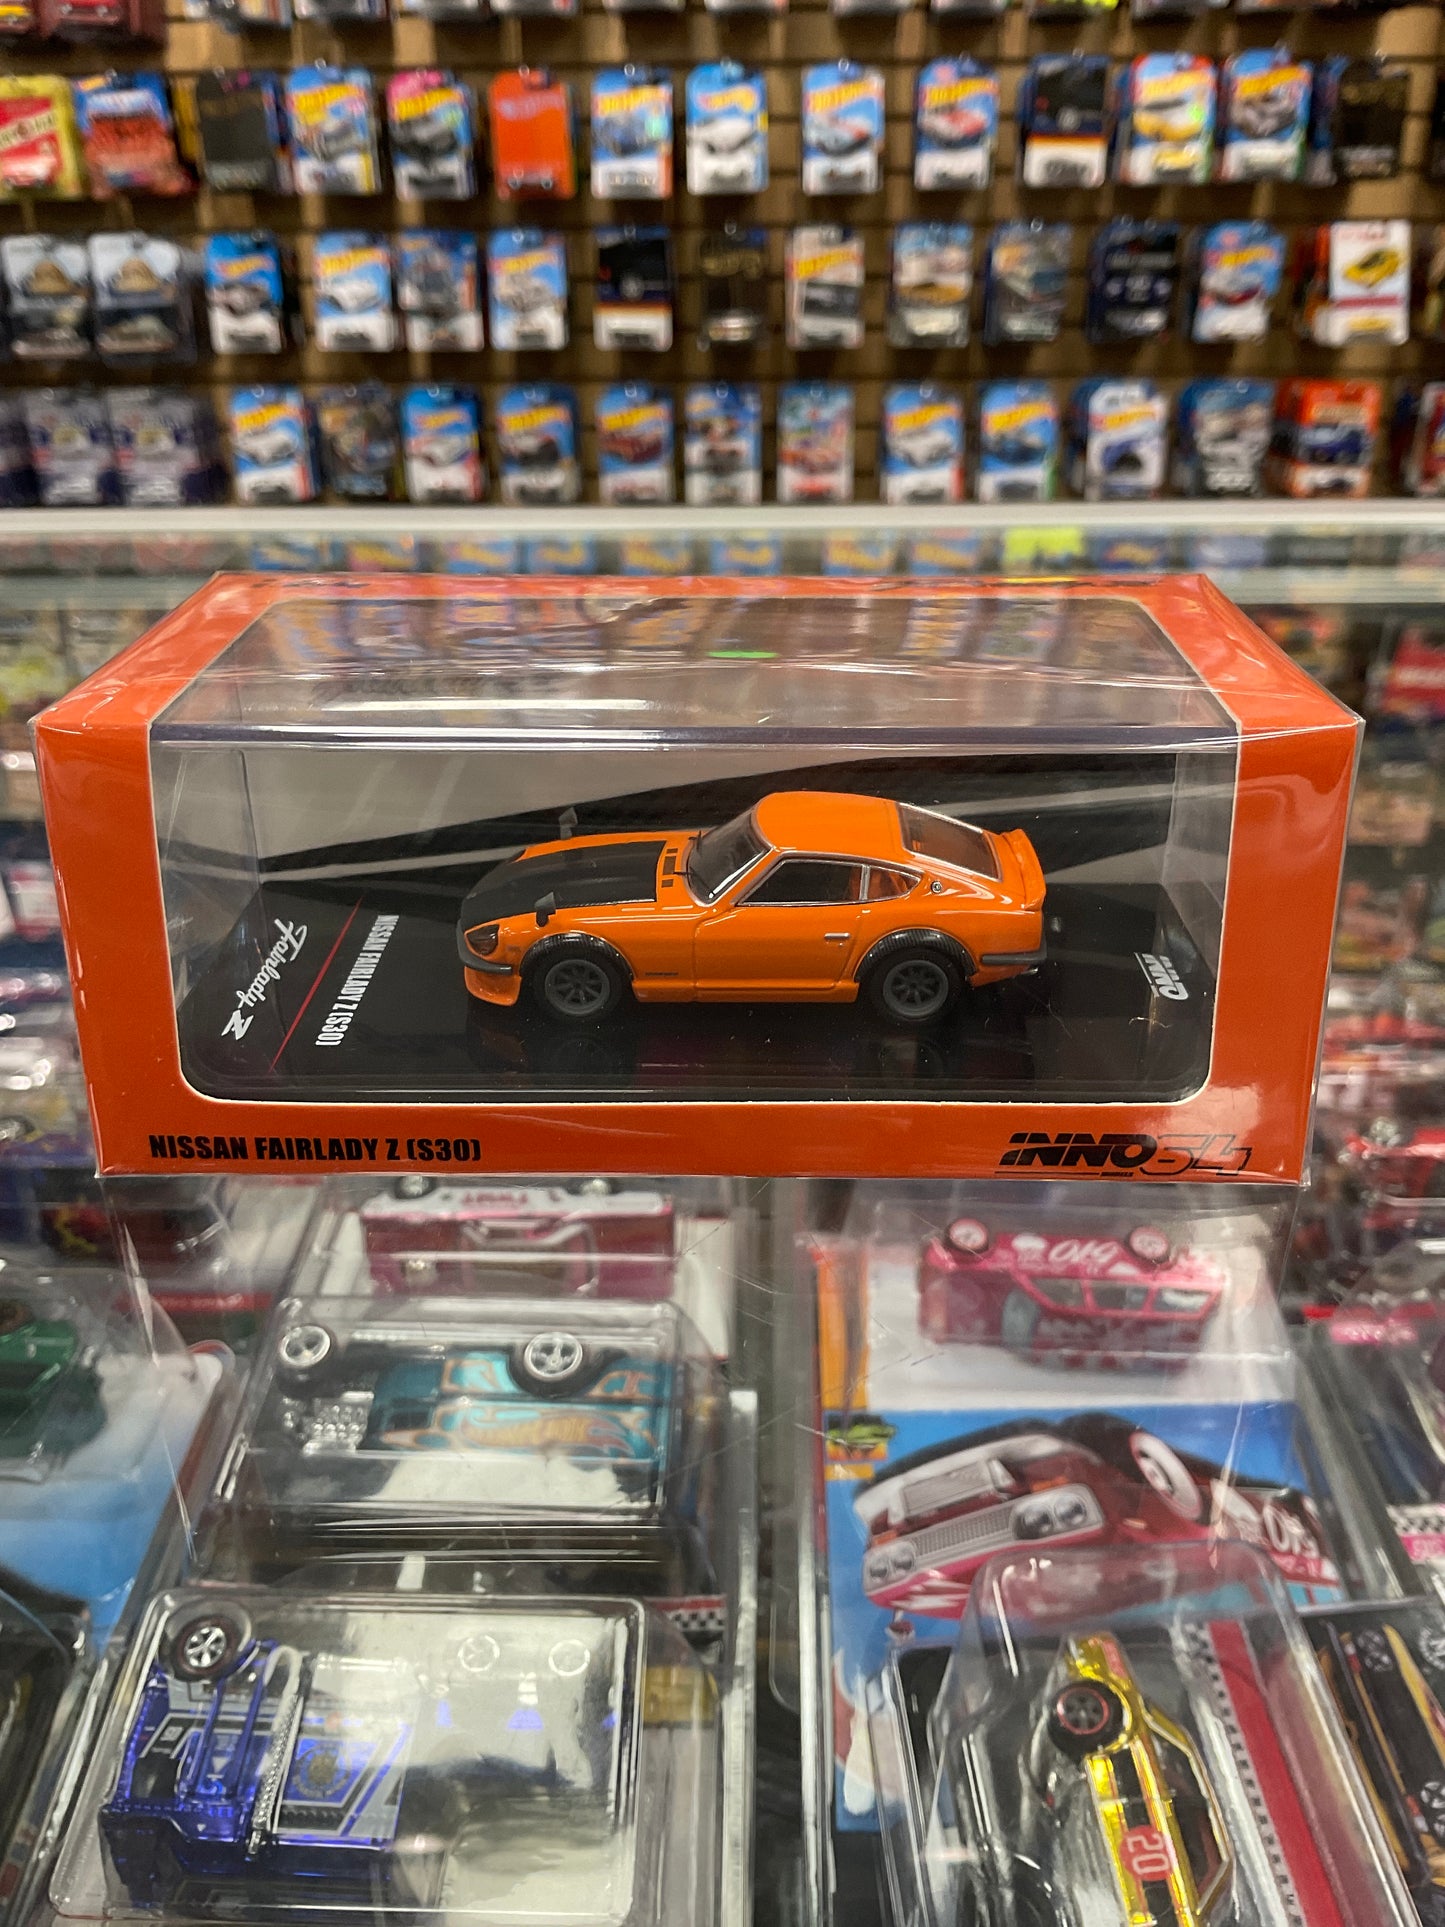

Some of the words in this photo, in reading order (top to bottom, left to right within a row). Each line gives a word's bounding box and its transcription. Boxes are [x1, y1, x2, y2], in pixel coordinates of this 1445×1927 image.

[362, 915, 399, 951] NISSAN
[236, 918, 307, 1008] Fairlady
[337, 952, 382, 1002] FAIRLADY
[332, 1002, 358, 1010] Z
[221, 1009, 254, 1040] Z
[149, 1135, 248, 1160] NISSAN
[254, 1137, 378, 1160] FAIRLADY
[386, 1138, 400, 1160] Z
[1127, 1832, 1170, 1875] 20
